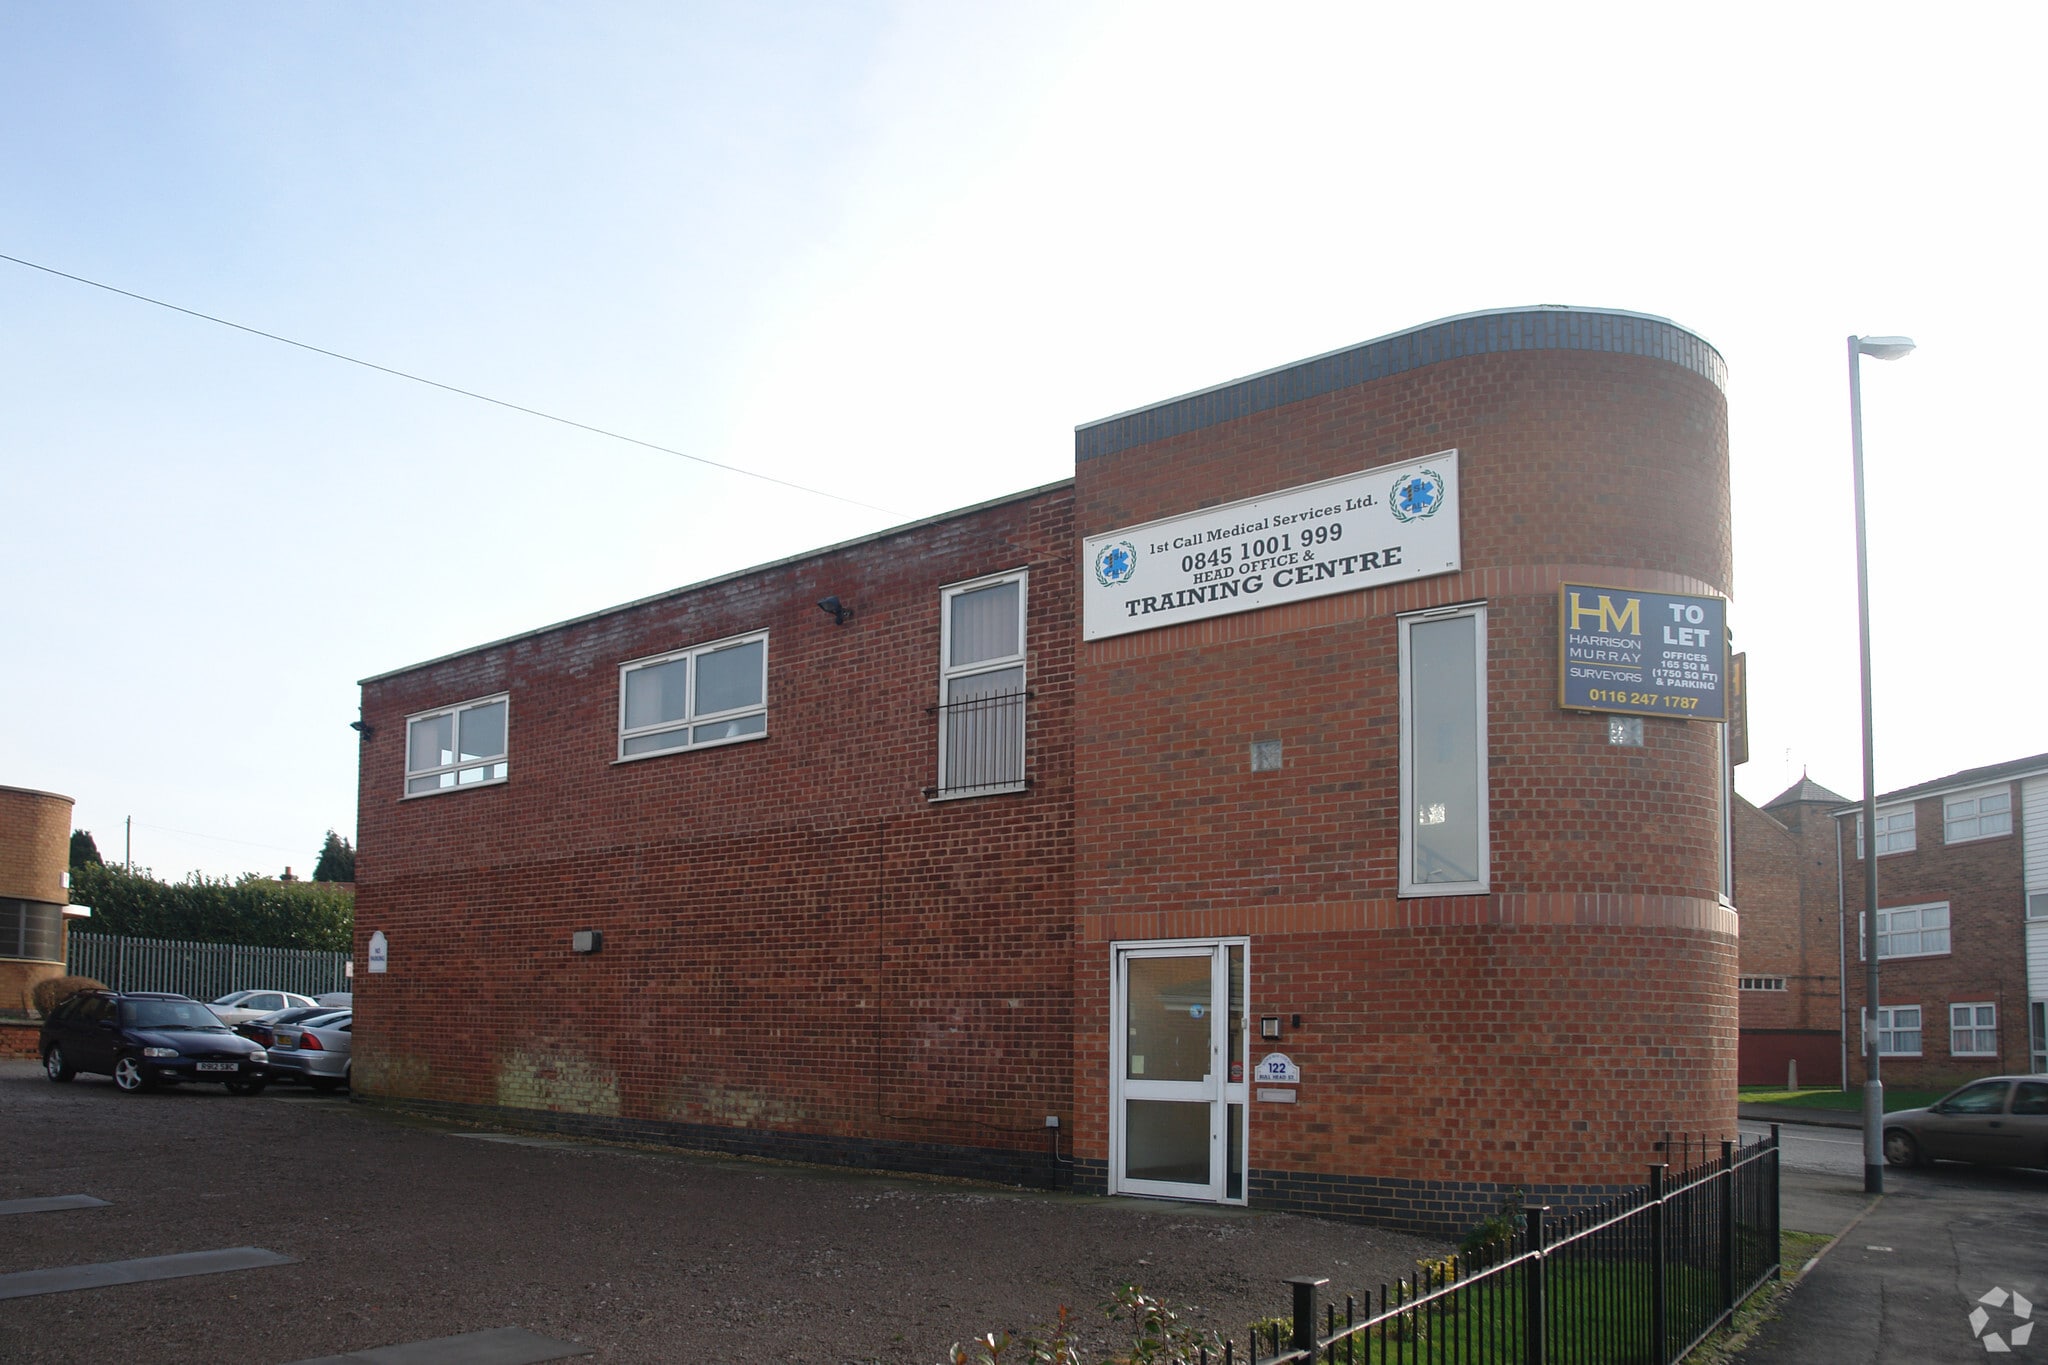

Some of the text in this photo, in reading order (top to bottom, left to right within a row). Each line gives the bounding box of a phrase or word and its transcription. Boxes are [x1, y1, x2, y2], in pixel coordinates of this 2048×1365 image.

[1404, 502, 1428, 512] CALL
[1149, 495, 1378, 555] 1st Call Medical Services Ltd.
[1181, 523, 1343, 572] 0845 1001 999
[1193, 550, 1315, 585] HEAD OFFICE &
[1125, 546, 1402, 617] TRAINING CENTRE
[1569, 592, 1642, 636] HM
[1668, 603, 1704, 624] TO
[1569, 634, 1642, 650] HARRISON
[1663, 625, 1711, 648] LET
[1569, 647, 1642, 663] MURRAY
[1662, 651, 1708, 662] OFFICES
[1661, 660, 1710, 672] 165 SQ M
[1569, 667, 1643, 683] SURVEYORS
[1652, 668, 1718, 683] (1750 SQ FT)
[1655, 678, 1715, 690] & PARKING
[1589, 688, 1699, 710] 0116 247 1787
[1268, 1062, 1286, 1073] 122
